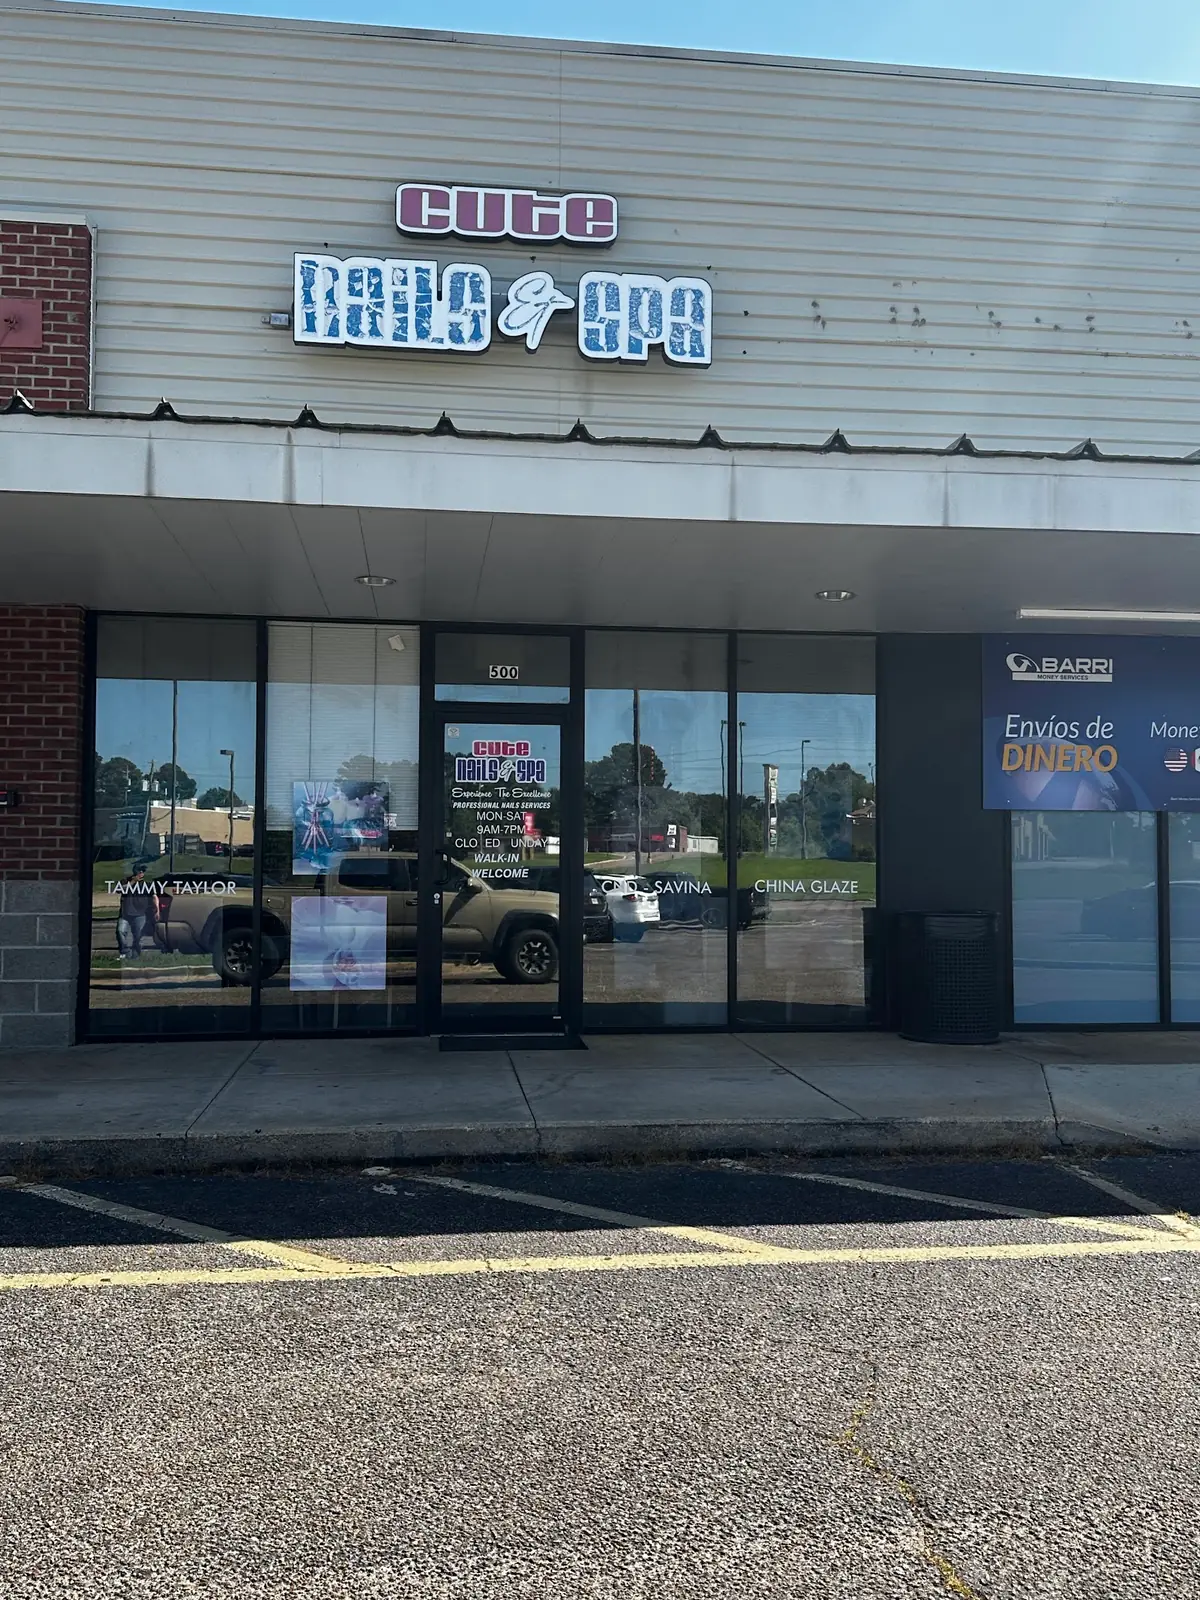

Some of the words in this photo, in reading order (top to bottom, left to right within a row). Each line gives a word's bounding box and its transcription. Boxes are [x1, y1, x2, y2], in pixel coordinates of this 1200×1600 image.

[490, 666, 518, 678] 500
[1042, 658, 1113, 673] BARRI
[1005, 714, 1079, 739] Envíos
[1085, 715, 1114, 739] de
[1150, 721, 1200, 738] Mone
[1002, 744, 1118, 772] DINERO
[452, 787, 492, 798] Experience
[494, 787, 511, 797] The
[512, 787, 552, 798] Excellence
[476, 811, 527, 821] MON-SAT
[476, 825, 526, 835] 9AM-7PM
[474, 853, 520, 863] WALK-IN
[472, 868, 529, 878] WELCOME
[105, 881, 168, 895] TAMMY
[173, 881, 236, 895] TAYLOR
[655, 881, 712, 894] SAVINA
[754, 879, 805, 893] CHINA
[810, 880, 859, 893] GLAZE
